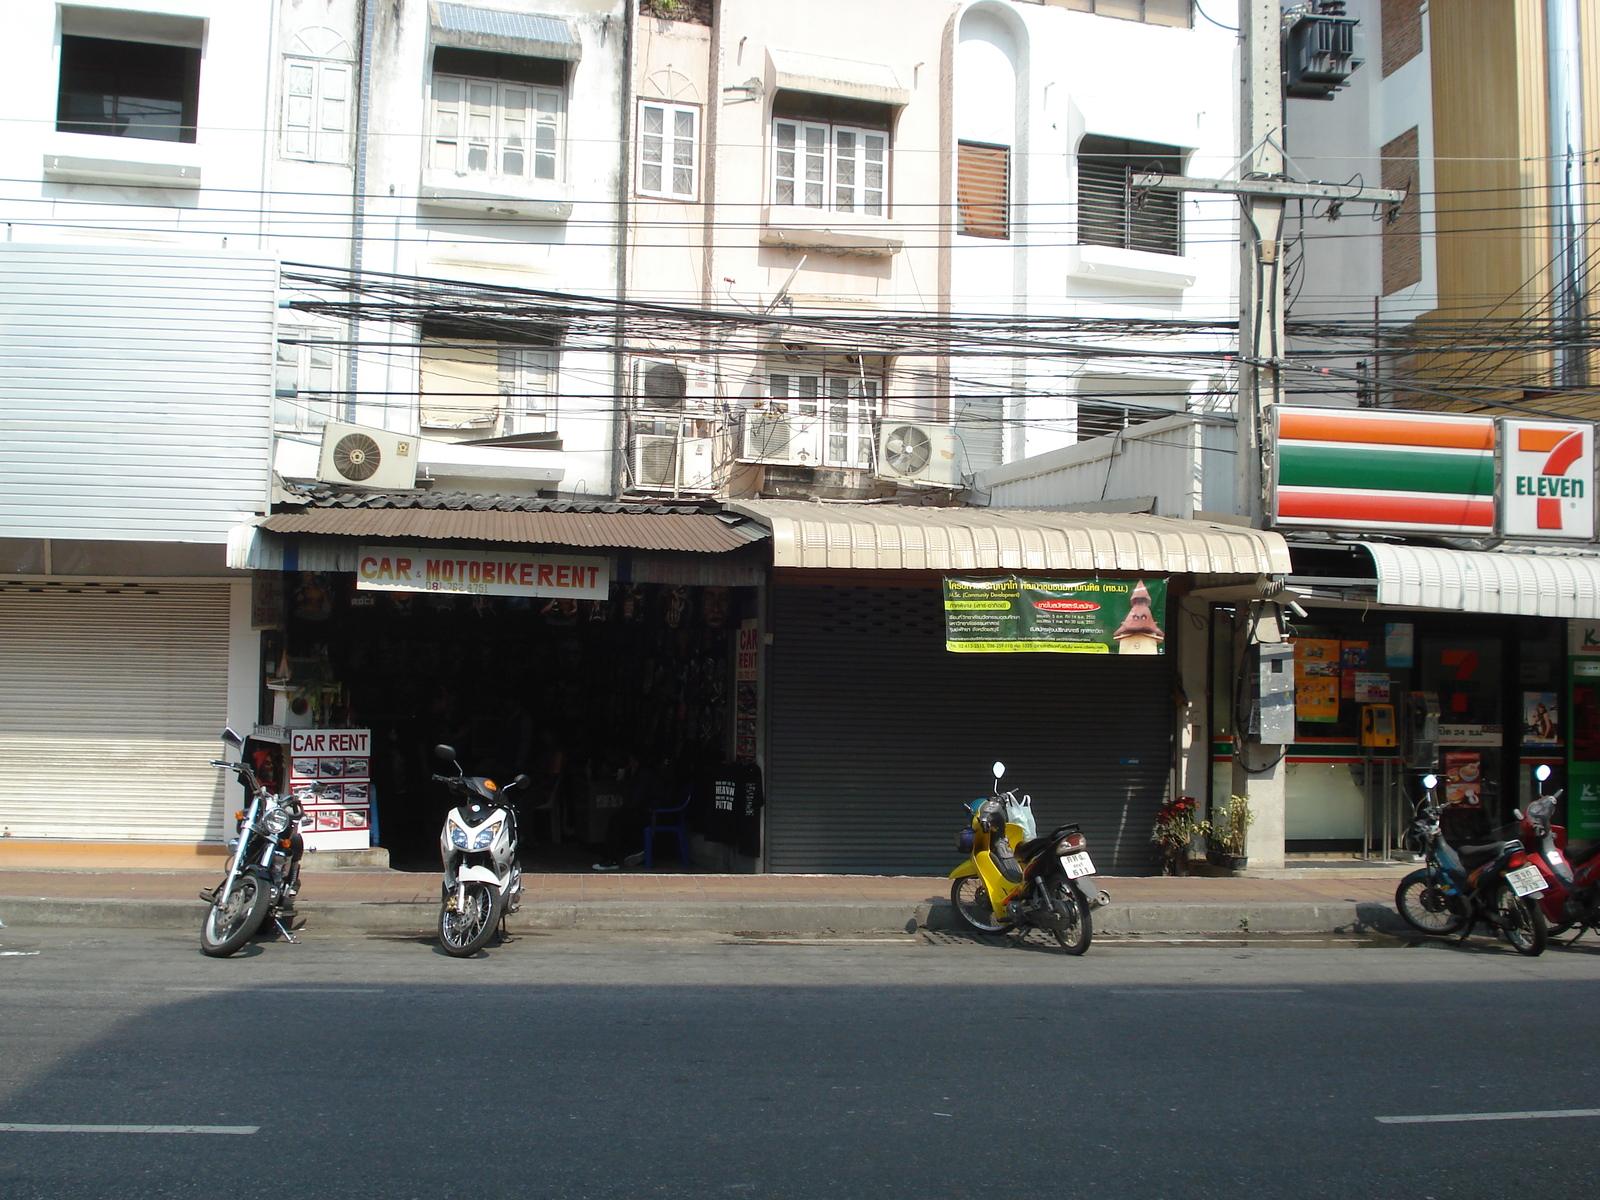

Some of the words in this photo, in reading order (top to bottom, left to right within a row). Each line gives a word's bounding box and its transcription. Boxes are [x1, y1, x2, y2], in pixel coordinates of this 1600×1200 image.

[1518, 427, 1584, 529] 7
[360, 557, 412, 581] CAR
[415, 570, 421, 578] &
[426, 559, 533, 585] MOTOBIKE
[538, 564, 599, 588] RENT
[740, 629, 758, 650] CAR
[738, 652, 758, 669] RENT
[293, 734, 326, 752] CAR
[329, 734, 368, 751] RENT
